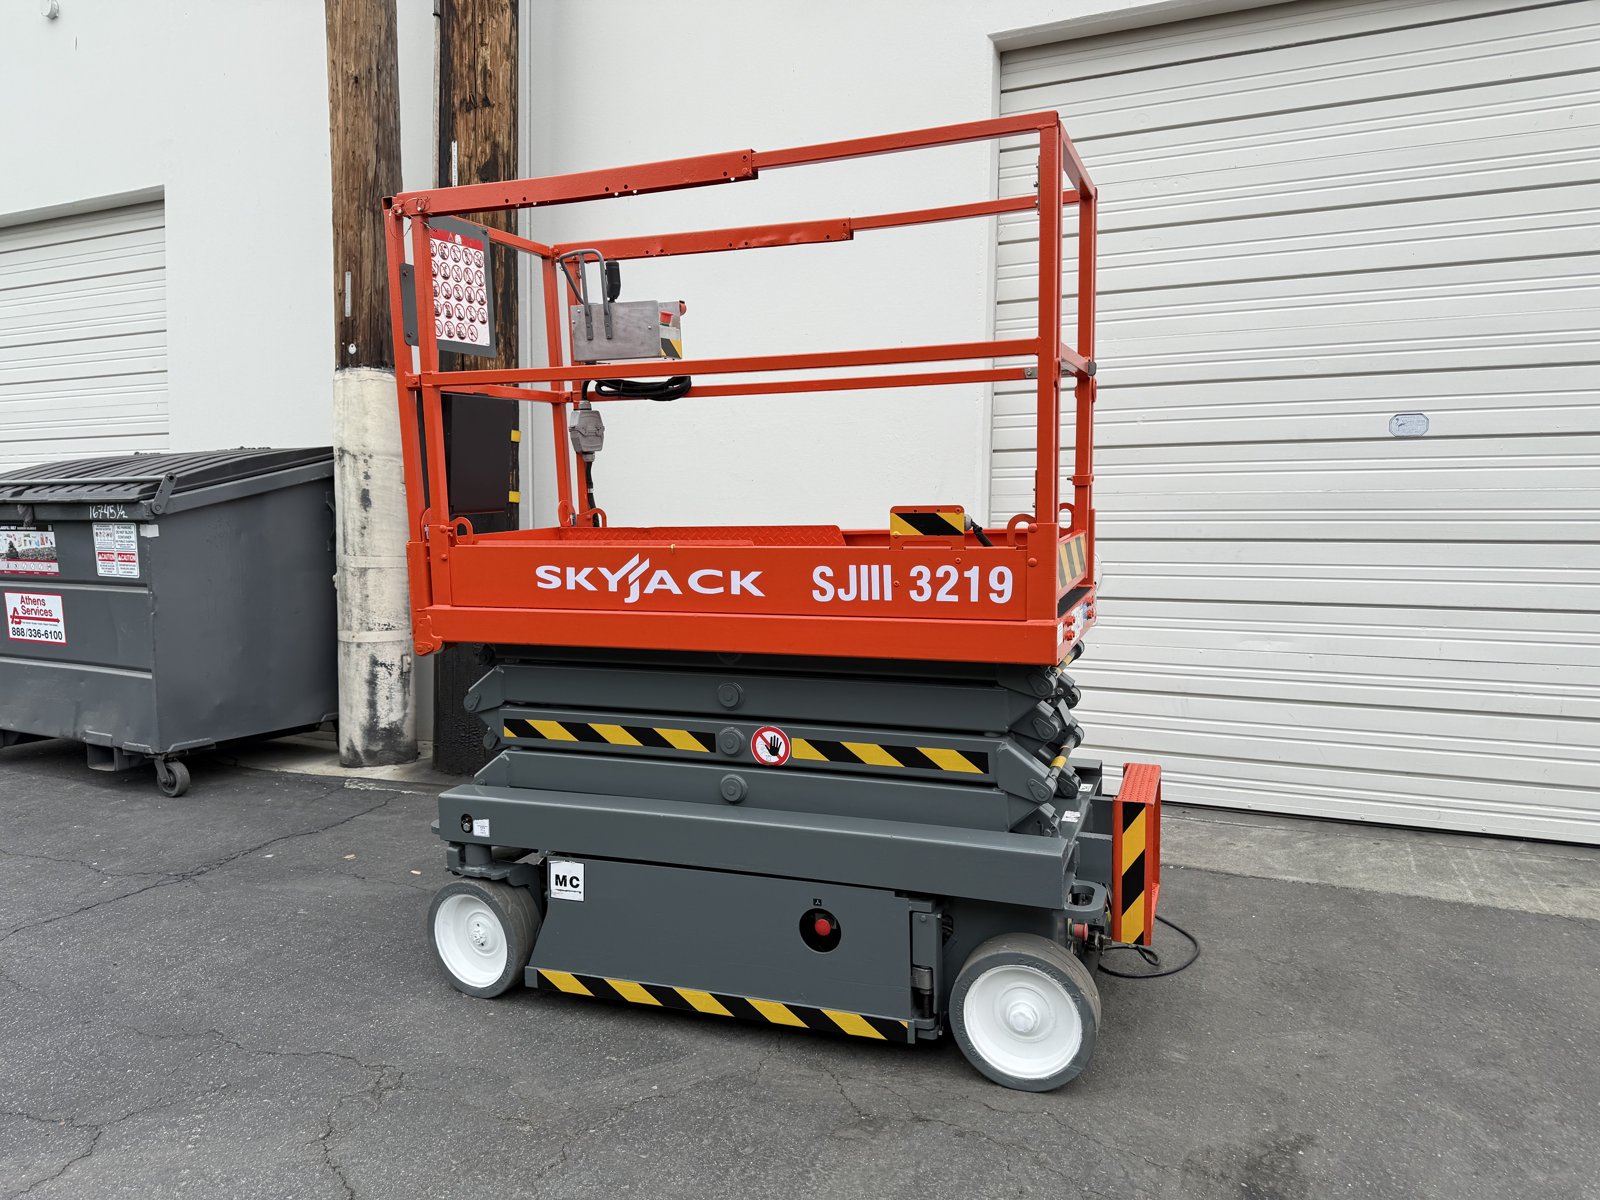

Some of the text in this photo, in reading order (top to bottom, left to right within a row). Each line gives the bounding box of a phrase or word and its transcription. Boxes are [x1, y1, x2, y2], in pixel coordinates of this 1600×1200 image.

[535, 553, 766, 604] SKYJACK
[812, 564, 1013, 604] SJIII 3219
[20, 595, 46, 606] Athens
[21, 605, 53, 617] Services
[11, 627, 63, 641] 888/336-6100
[555, 874, 580, 889] MC
